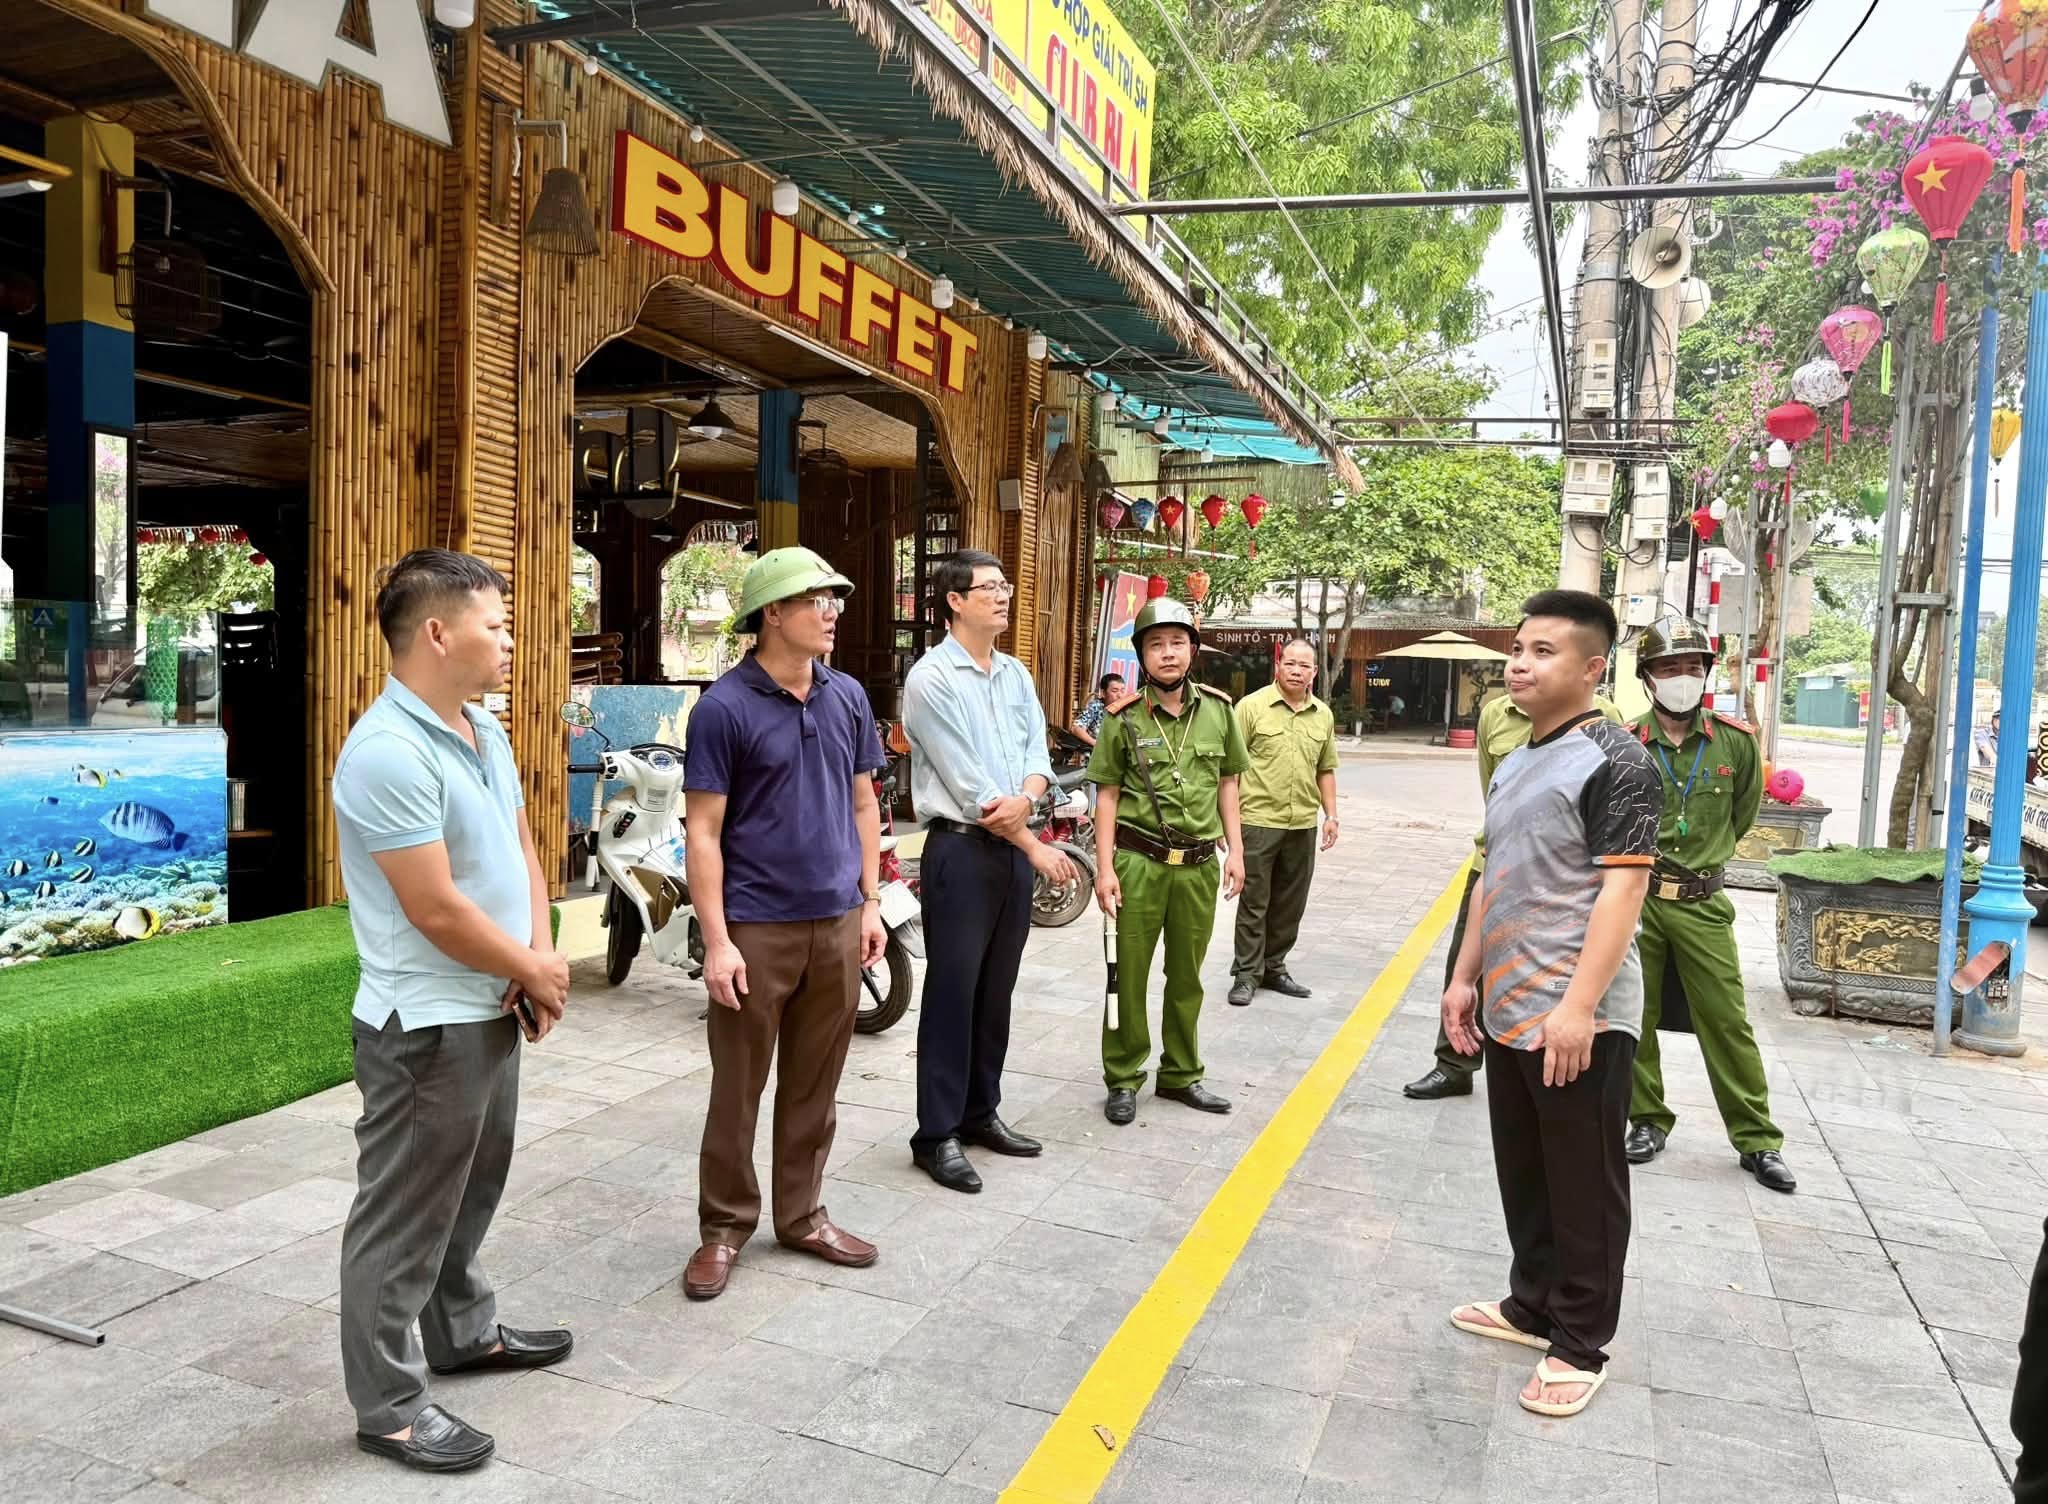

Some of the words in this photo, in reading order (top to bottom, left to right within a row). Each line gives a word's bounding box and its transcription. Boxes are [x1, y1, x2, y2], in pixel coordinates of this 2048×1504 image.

[1092, 22, 1115, 79] GIẢI
[1117, 49, 1135, 99] TRÍ
[1134, 74, 1148, 118] SH
[614, 131, 977, 394] BUFFET
[1216, 632, 1242, 643] SINH
[1269, 631, 1293, 643] TRÀ
